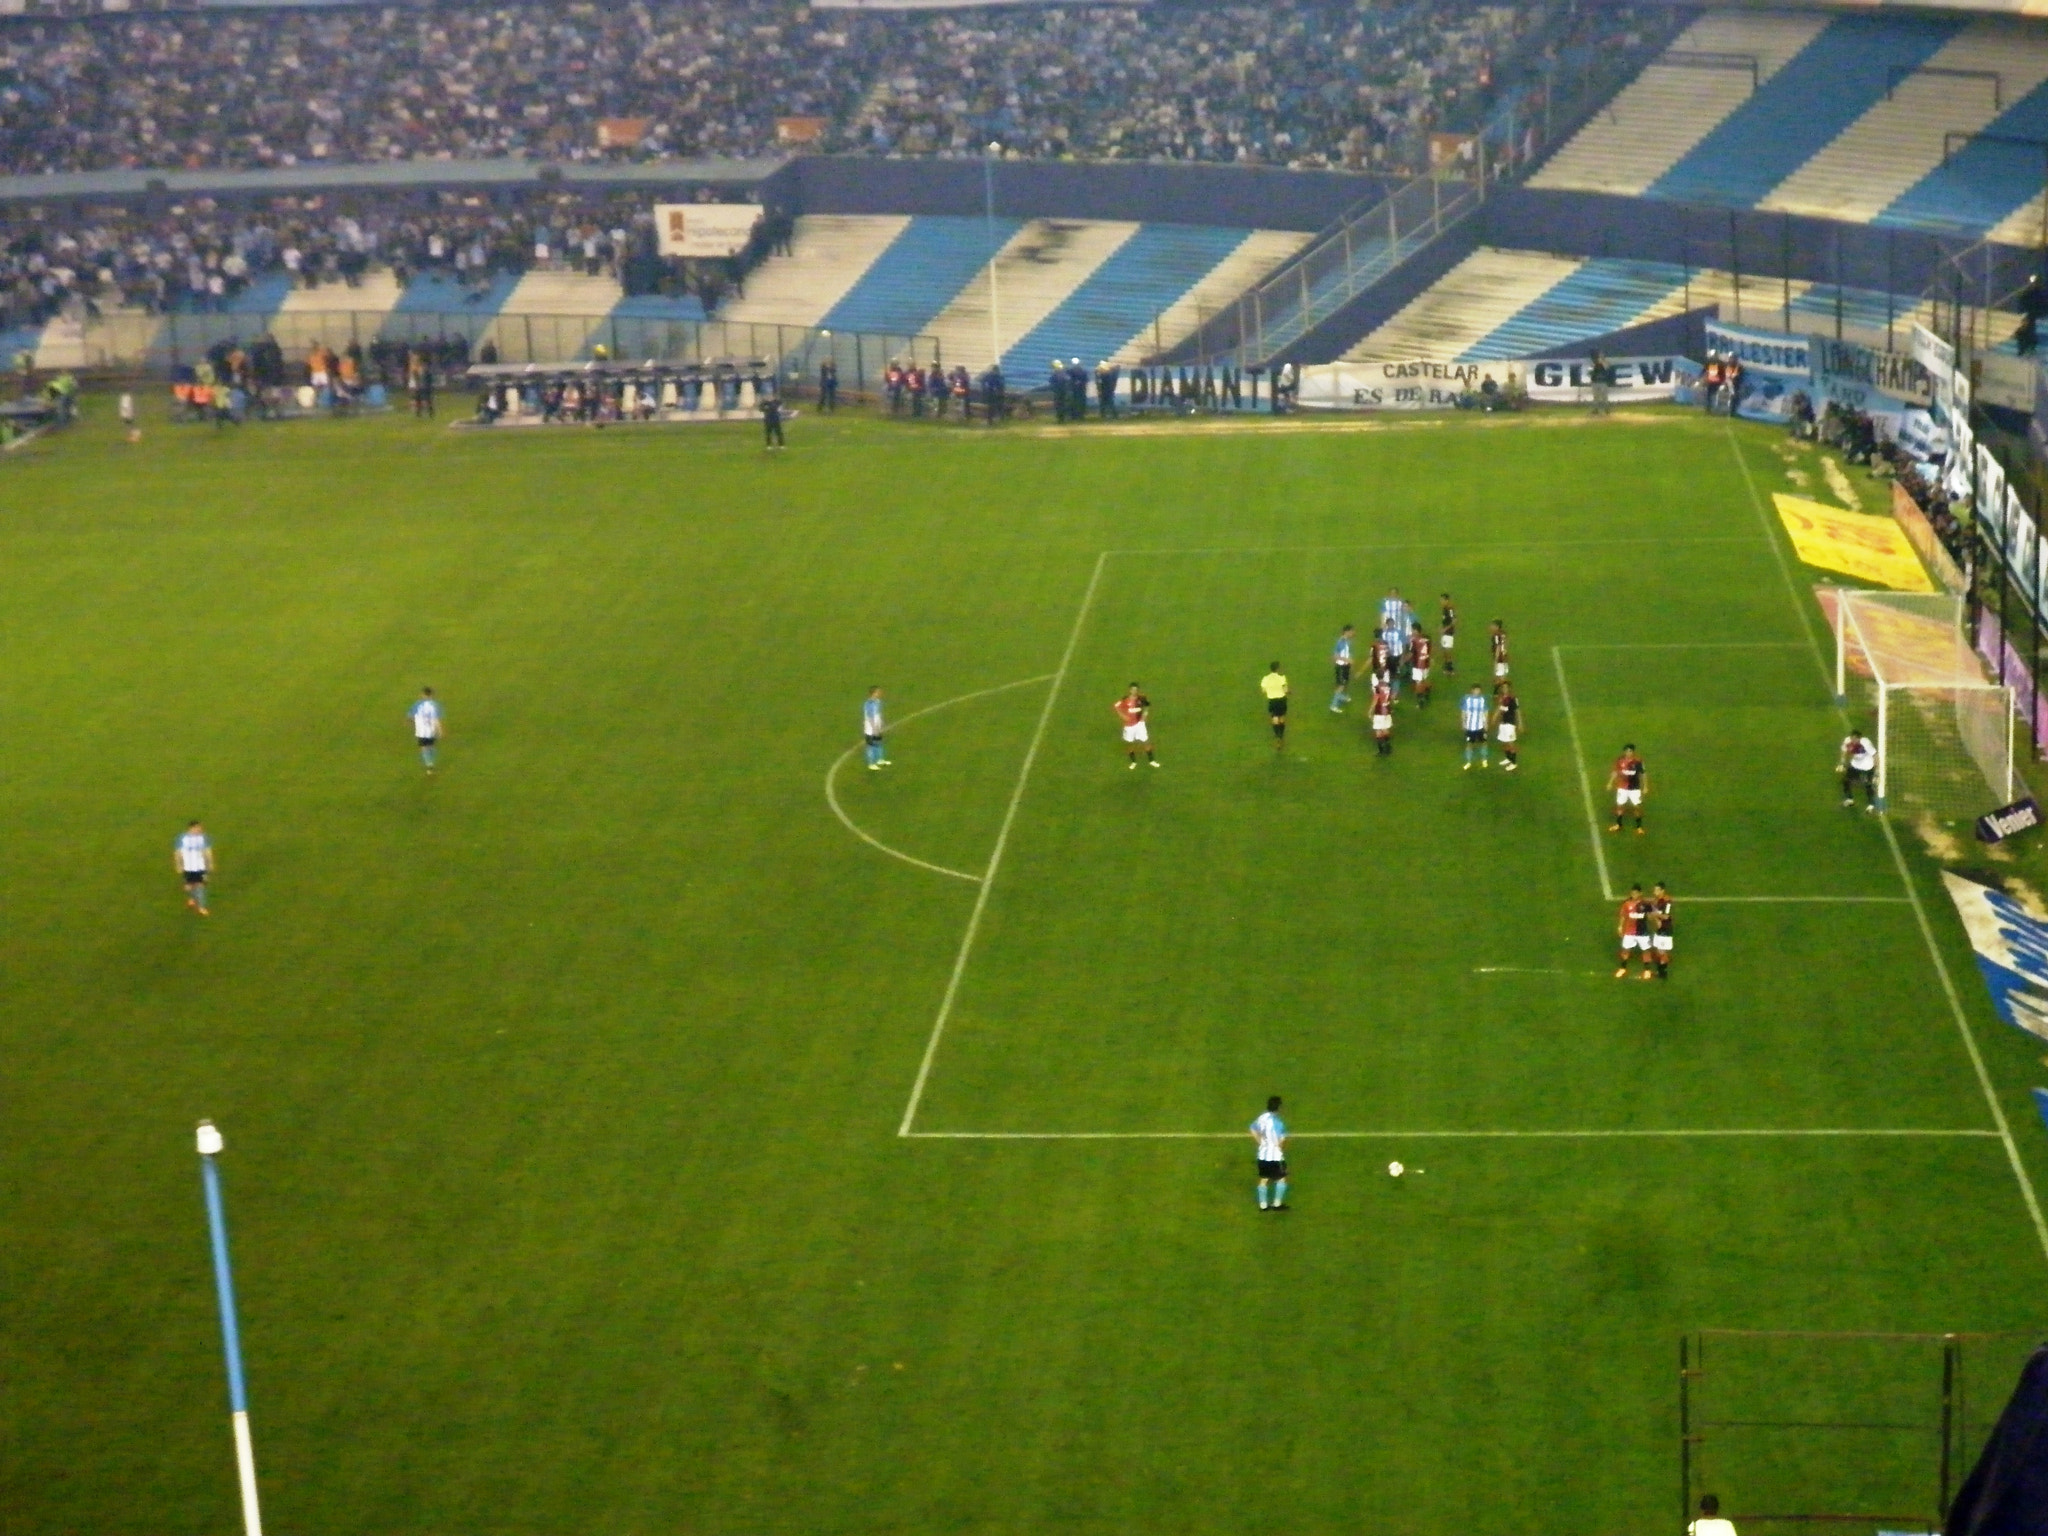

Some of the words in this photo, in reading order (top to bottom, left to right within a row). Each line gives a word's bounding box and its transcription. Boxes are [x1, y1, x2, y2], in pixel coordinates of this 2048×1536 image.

[1383, 361, 1478, 380] CASTELAR
[1534, 359, 1673, 388] GLEW
[1354, 388, 1383, 405] ES
[1395, 386, 1422, 402] DE
